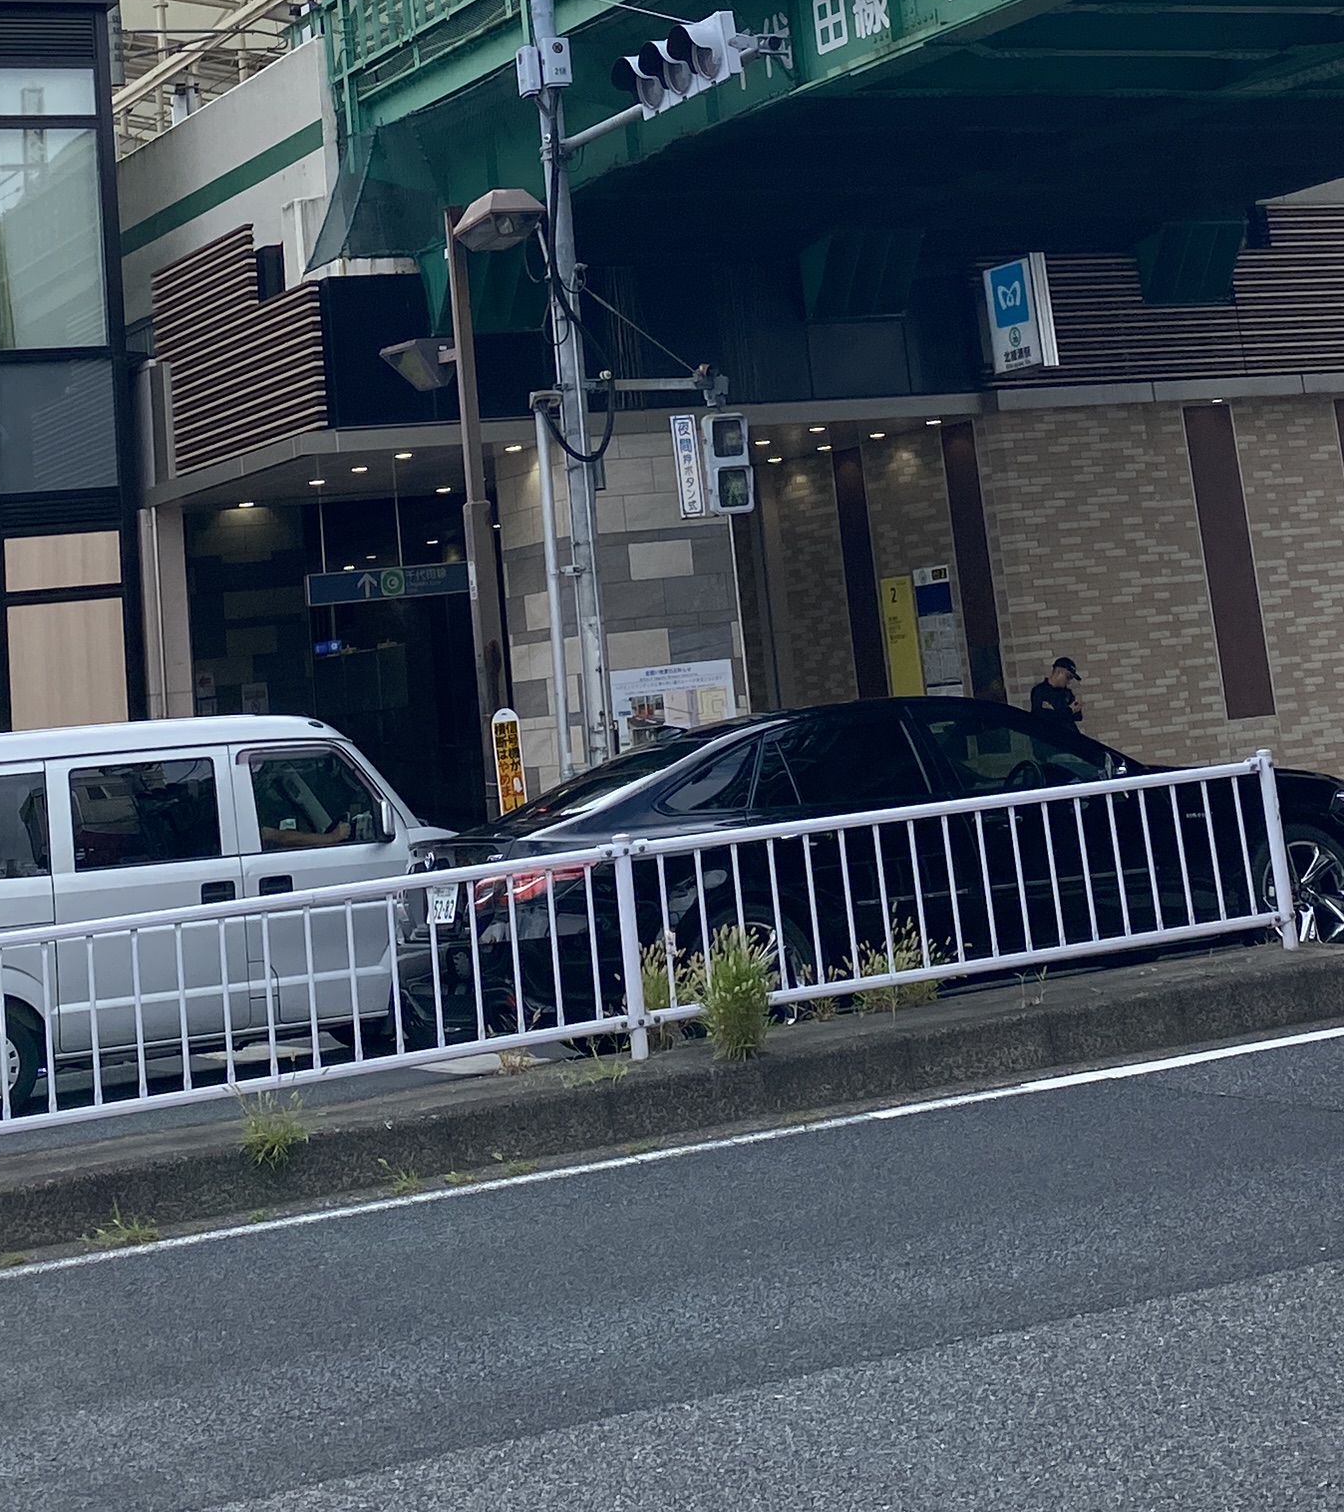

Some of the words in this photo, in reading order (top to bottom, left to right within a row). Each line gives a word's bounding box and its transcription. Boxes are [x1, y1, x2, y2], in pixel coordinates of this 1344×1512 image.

[677, 421, 698, 511] 夜間押ボタン式
